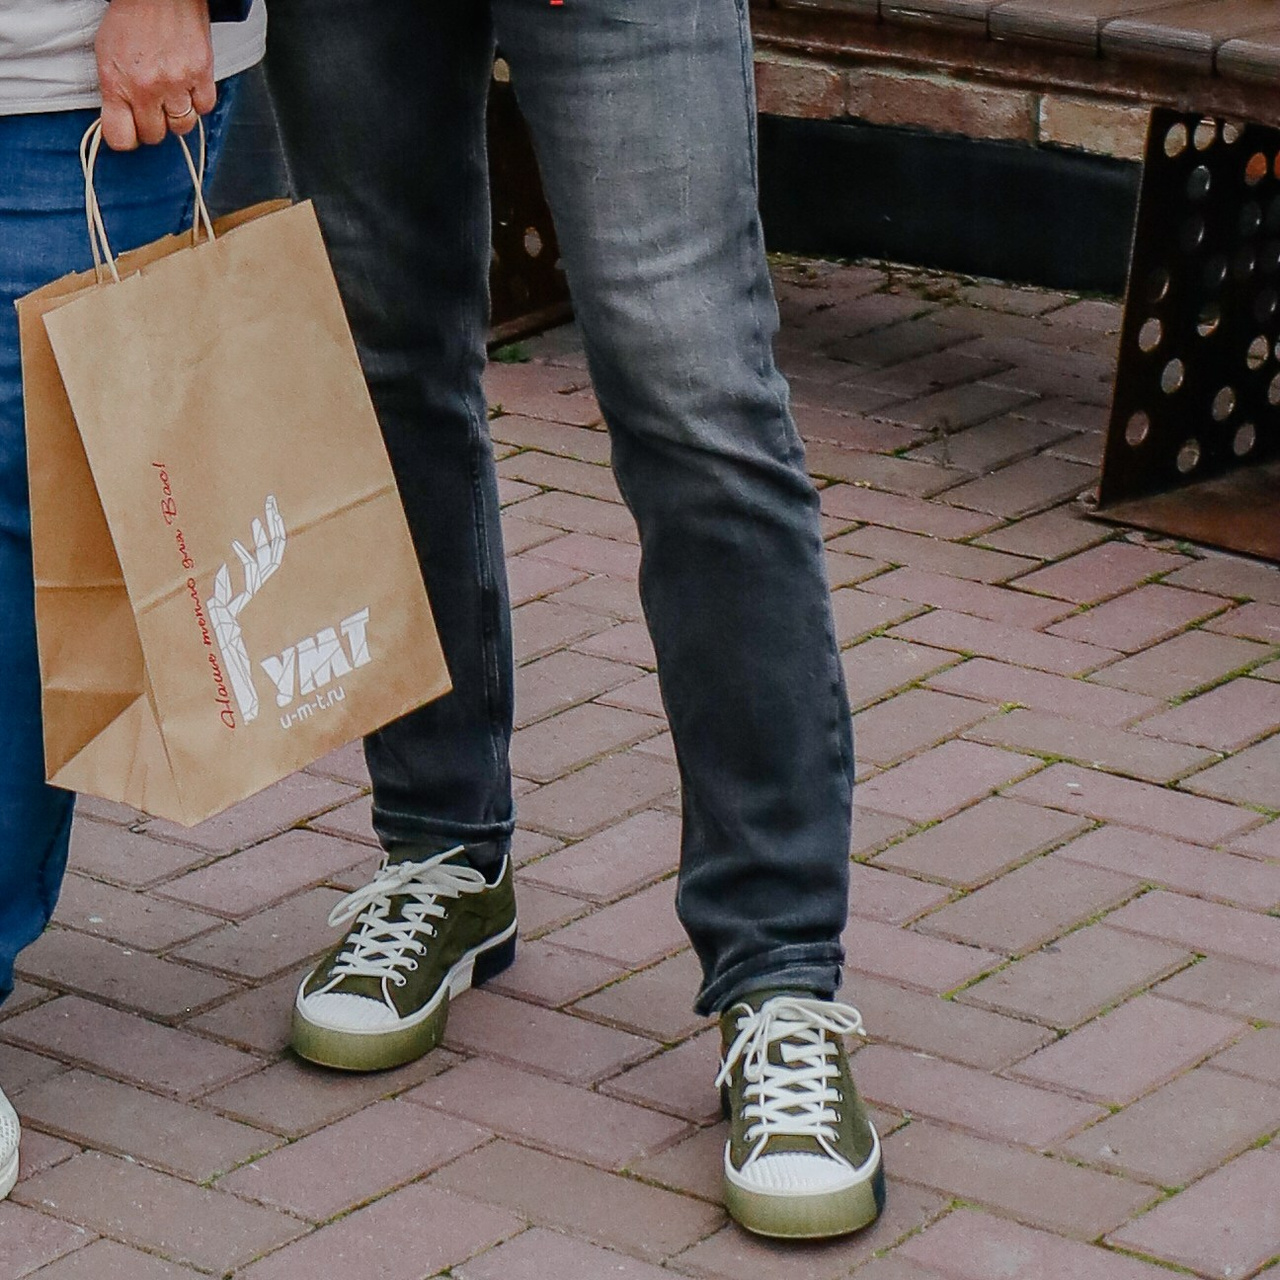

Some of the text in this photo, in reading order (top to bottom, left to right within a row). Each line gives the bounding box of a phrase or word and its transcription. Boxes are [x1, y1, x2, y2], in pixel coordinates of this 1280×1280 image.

[152, 462, 236, 730] Наше тепло для Вас!
[260, 606, 372, 709] УМТ
[279, 686, 347, 730] u-m-t.ru
